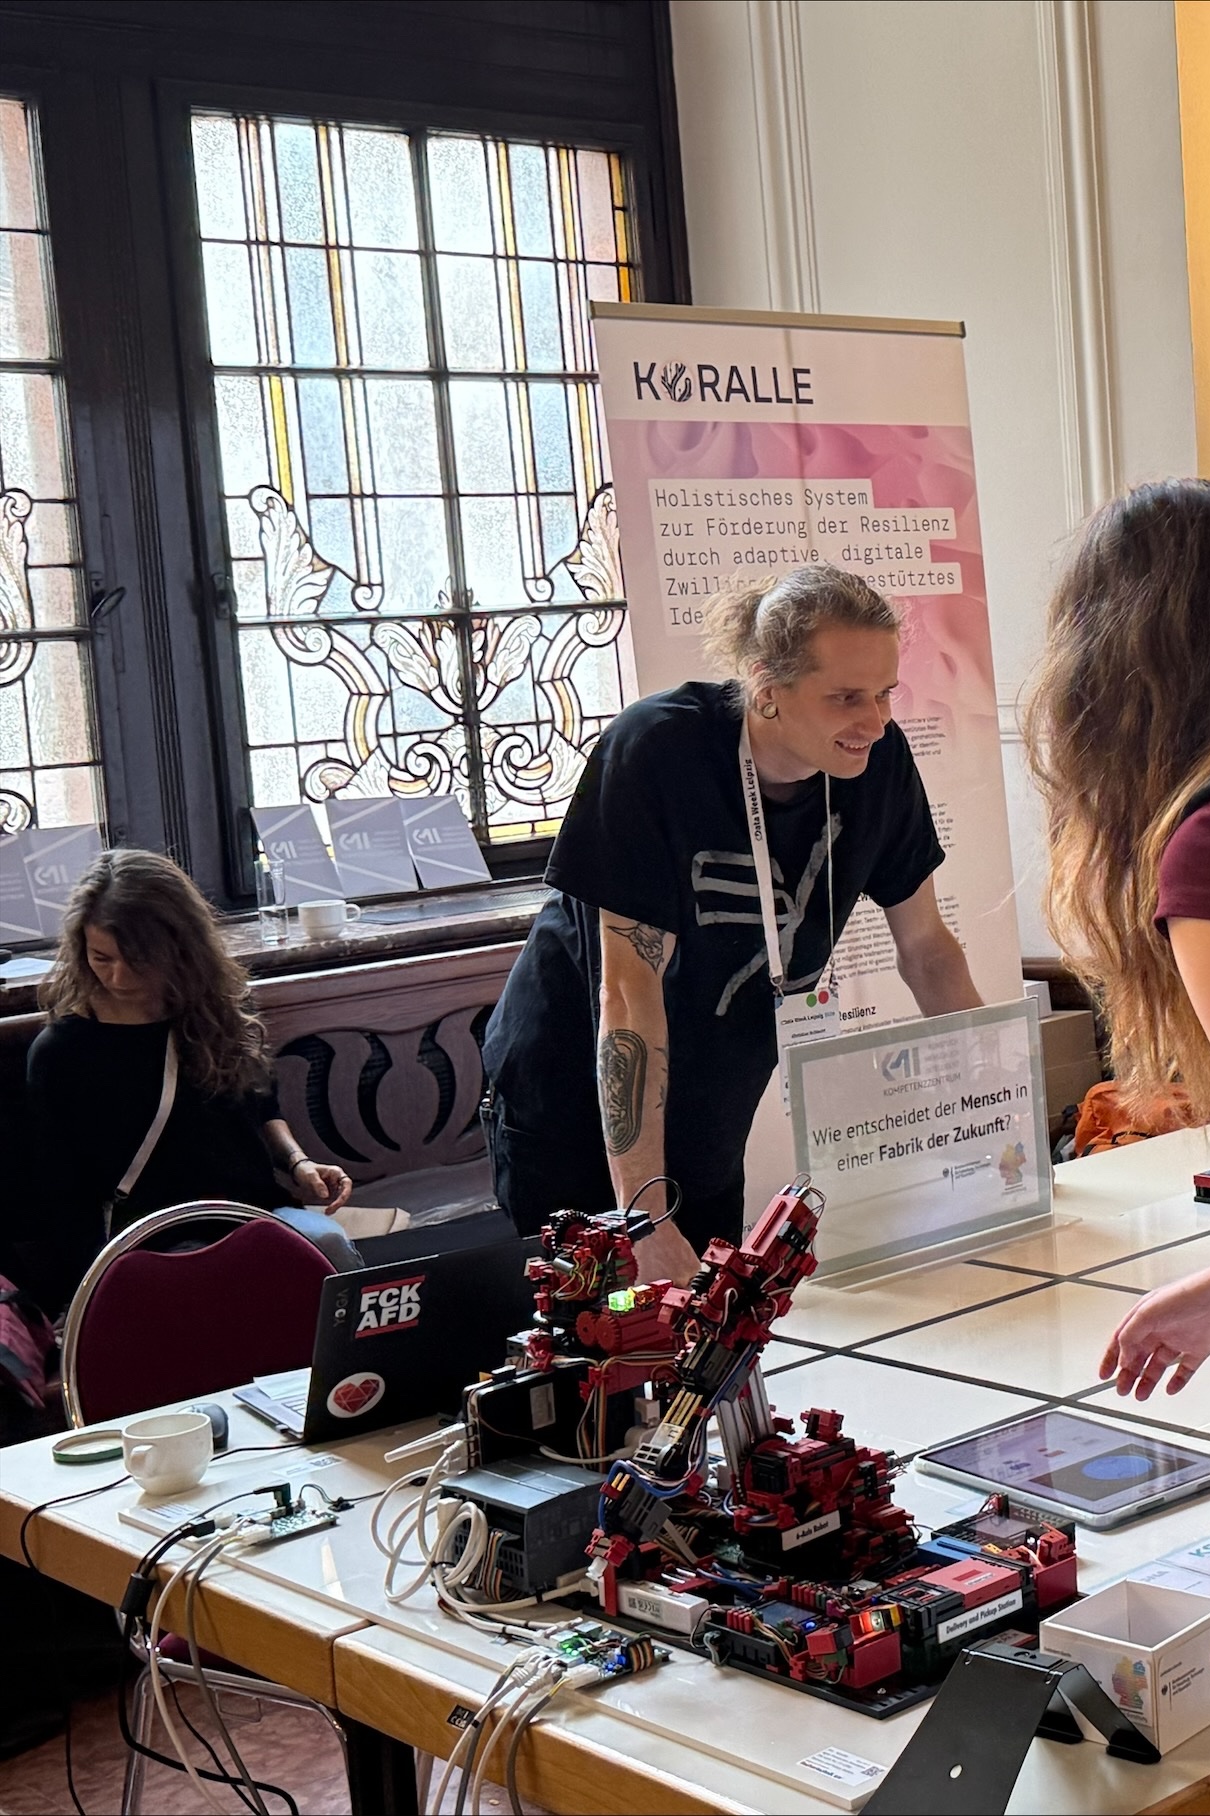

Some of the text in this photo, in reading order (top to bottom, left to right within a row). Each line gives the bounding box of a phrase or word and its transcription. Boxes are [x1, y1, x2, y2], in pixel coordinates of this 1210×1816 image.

[633, 360, 814, 405] KORALLE
[655, 488, 868, 511] Holistisches System
[660, 514, 951, 540] zur Förderung der Resilienz
[663, 547, 721, 566] durch
[841, 542, 924, 564] digitale
[743, 759, 764, 842] Data Week Leipzig
[883, 1072, 961, 1097] KOMPETENZZENTRUM
[812, 1082, 1028, 1147] Wie entscheidet der Mensch in
[837, 1113, 1012, 1171] einer Fabrik der Zukunft?
[360, 1283, 422, 1313] FCK
[357, 1302, 422, 1332] AFD
